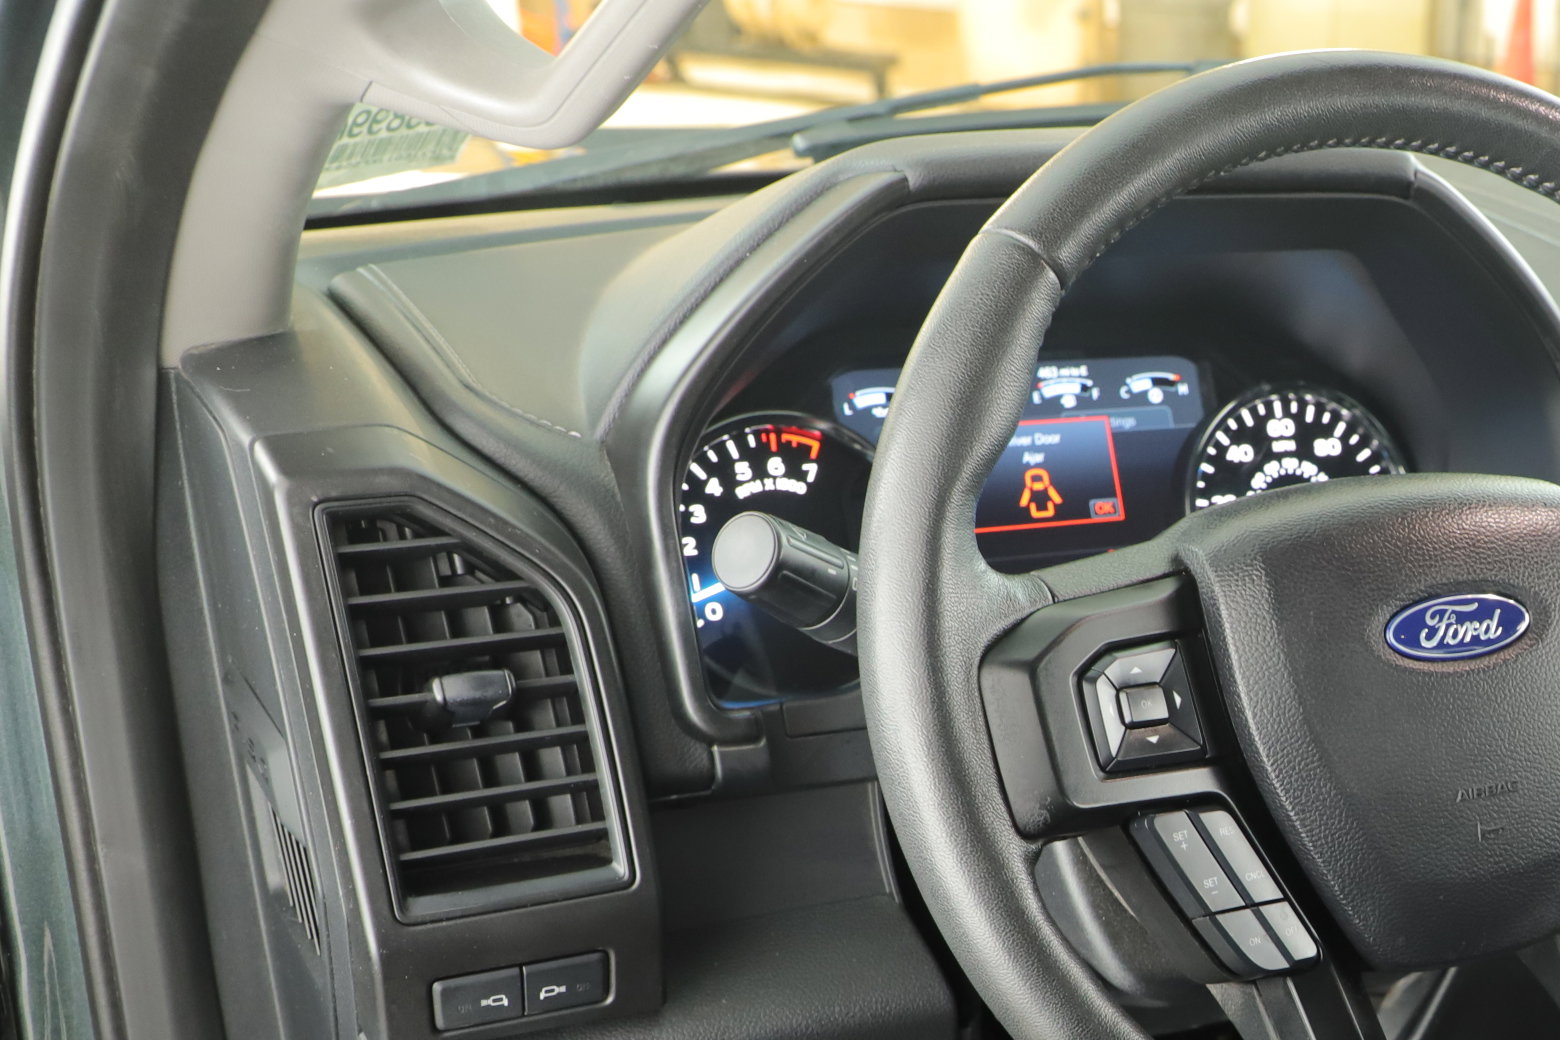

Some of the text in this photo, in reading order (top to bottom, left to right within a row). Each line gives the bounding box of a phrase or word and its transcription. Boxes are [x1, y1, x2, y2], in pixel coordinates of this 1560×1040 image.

[1022, 452, 1045, 466] Ajar
[1226, 444, 1255, 463] 40
[734, 461, 753, 482] 5
[767, 456, 786, 477] 6
[802, 462, 818, 483] 7
[704, 477, 724, 497] 4
[688, 504, 707, 524] 3
[1094, 502, 1116, 516] OK
[681, 536, 699, 556] 2
[704, 601, 724, 621] 0
[1419, 602, 1503, 649] Ford
[1172, 830, 1188, 842] SET
[1203, 877, 1219, 889] SET
